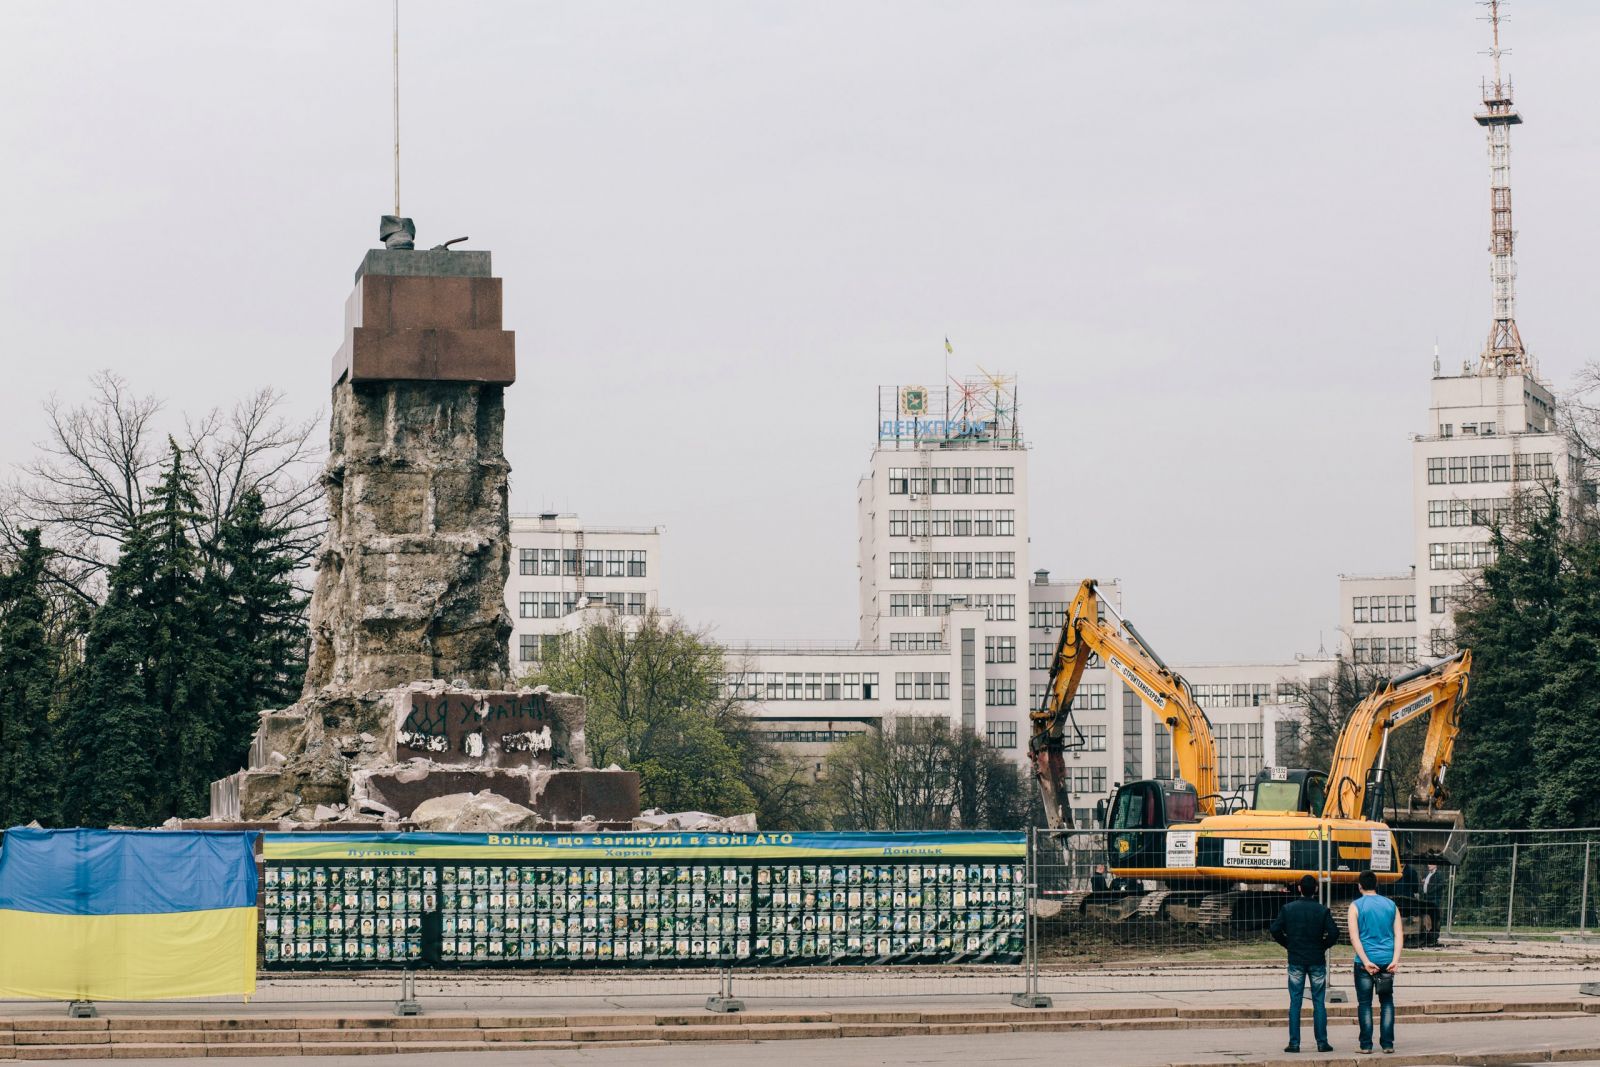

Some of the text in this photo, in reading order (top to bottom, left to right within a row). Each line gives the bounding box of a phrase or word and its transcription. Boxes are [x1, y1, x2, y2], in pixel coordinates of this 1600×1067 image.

[880, 419, 985, 437] ДЕРЖПРОМ
[487, 834, 549, 847] Воїни,
[557, 837, 584, 847] що
[592, 836, 682, 847] загинули
[707, 834, 747, 845] зоні
[755, 833, 793, 845] АТО
[347, 848, 416, 857] Луганськ
[605, 849, 653, 857] Харків
[882, 847, 943, 856] Донецьк
[1226, 857, 1287, 866] СТРОЙТЕХНОСЕРВИС
